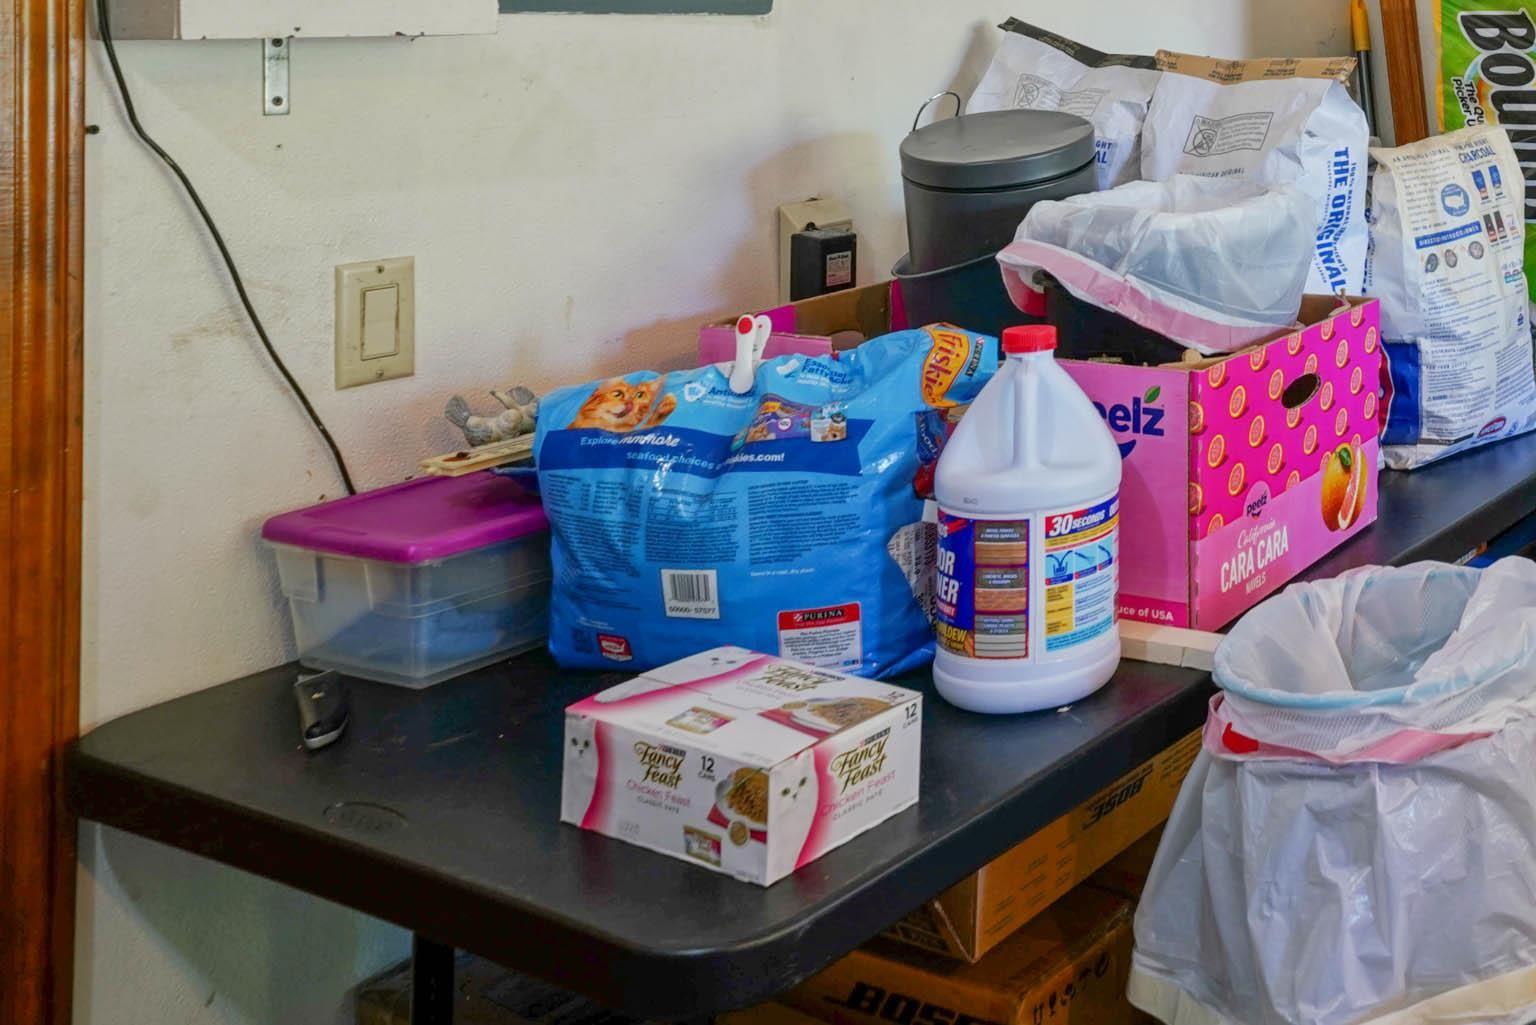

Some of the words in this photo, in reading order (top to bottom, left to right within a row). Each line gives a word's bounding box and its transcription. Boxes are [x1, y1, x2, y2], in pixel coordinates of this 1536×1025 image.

[1452, 77, 1472, 115] Picker
[1465, 80, 1478, 103] The
[1334, 146, 1350, 189] THE
[1458, 146, 1497, 164] CHARCOAL
[1316, 193, 1347, 293] ORIGINAL
[580, 435, 618, 447] Explore
[1246, 493, 1269, 517] peelz
[1049, 515, 1073, 537] 30
[1073, 509, 1106, 529] SECONDS
[1236, 518, 1276, 550] California
[1220, 545, 1255, 594] CARA
[1256, 525, 1290, 569] CARA
[1245, 572, 1267, 595] NAVELS
[803, 608, 844, 621] PURINA
[1138, 607, 1150, 617] of
[1151, 608, 1175, 622] USA
[904, 704, 918, 720] 12
[633, 740, 686, 775] Fancy
[700, 755, 715, 774] 12
[830, 736, 889, 776] Fancy
[641, 760, 683, 791] Feast
[841, 755, 888, 795] Feast
[626, 780, 662, 803] Chicken
[663, 791, 692, 809] Feast
[822, 785, 866, 818] Chicken
[865, 772, 897, 796] Feast
[833, 802, 864, 821] CLASSIC
